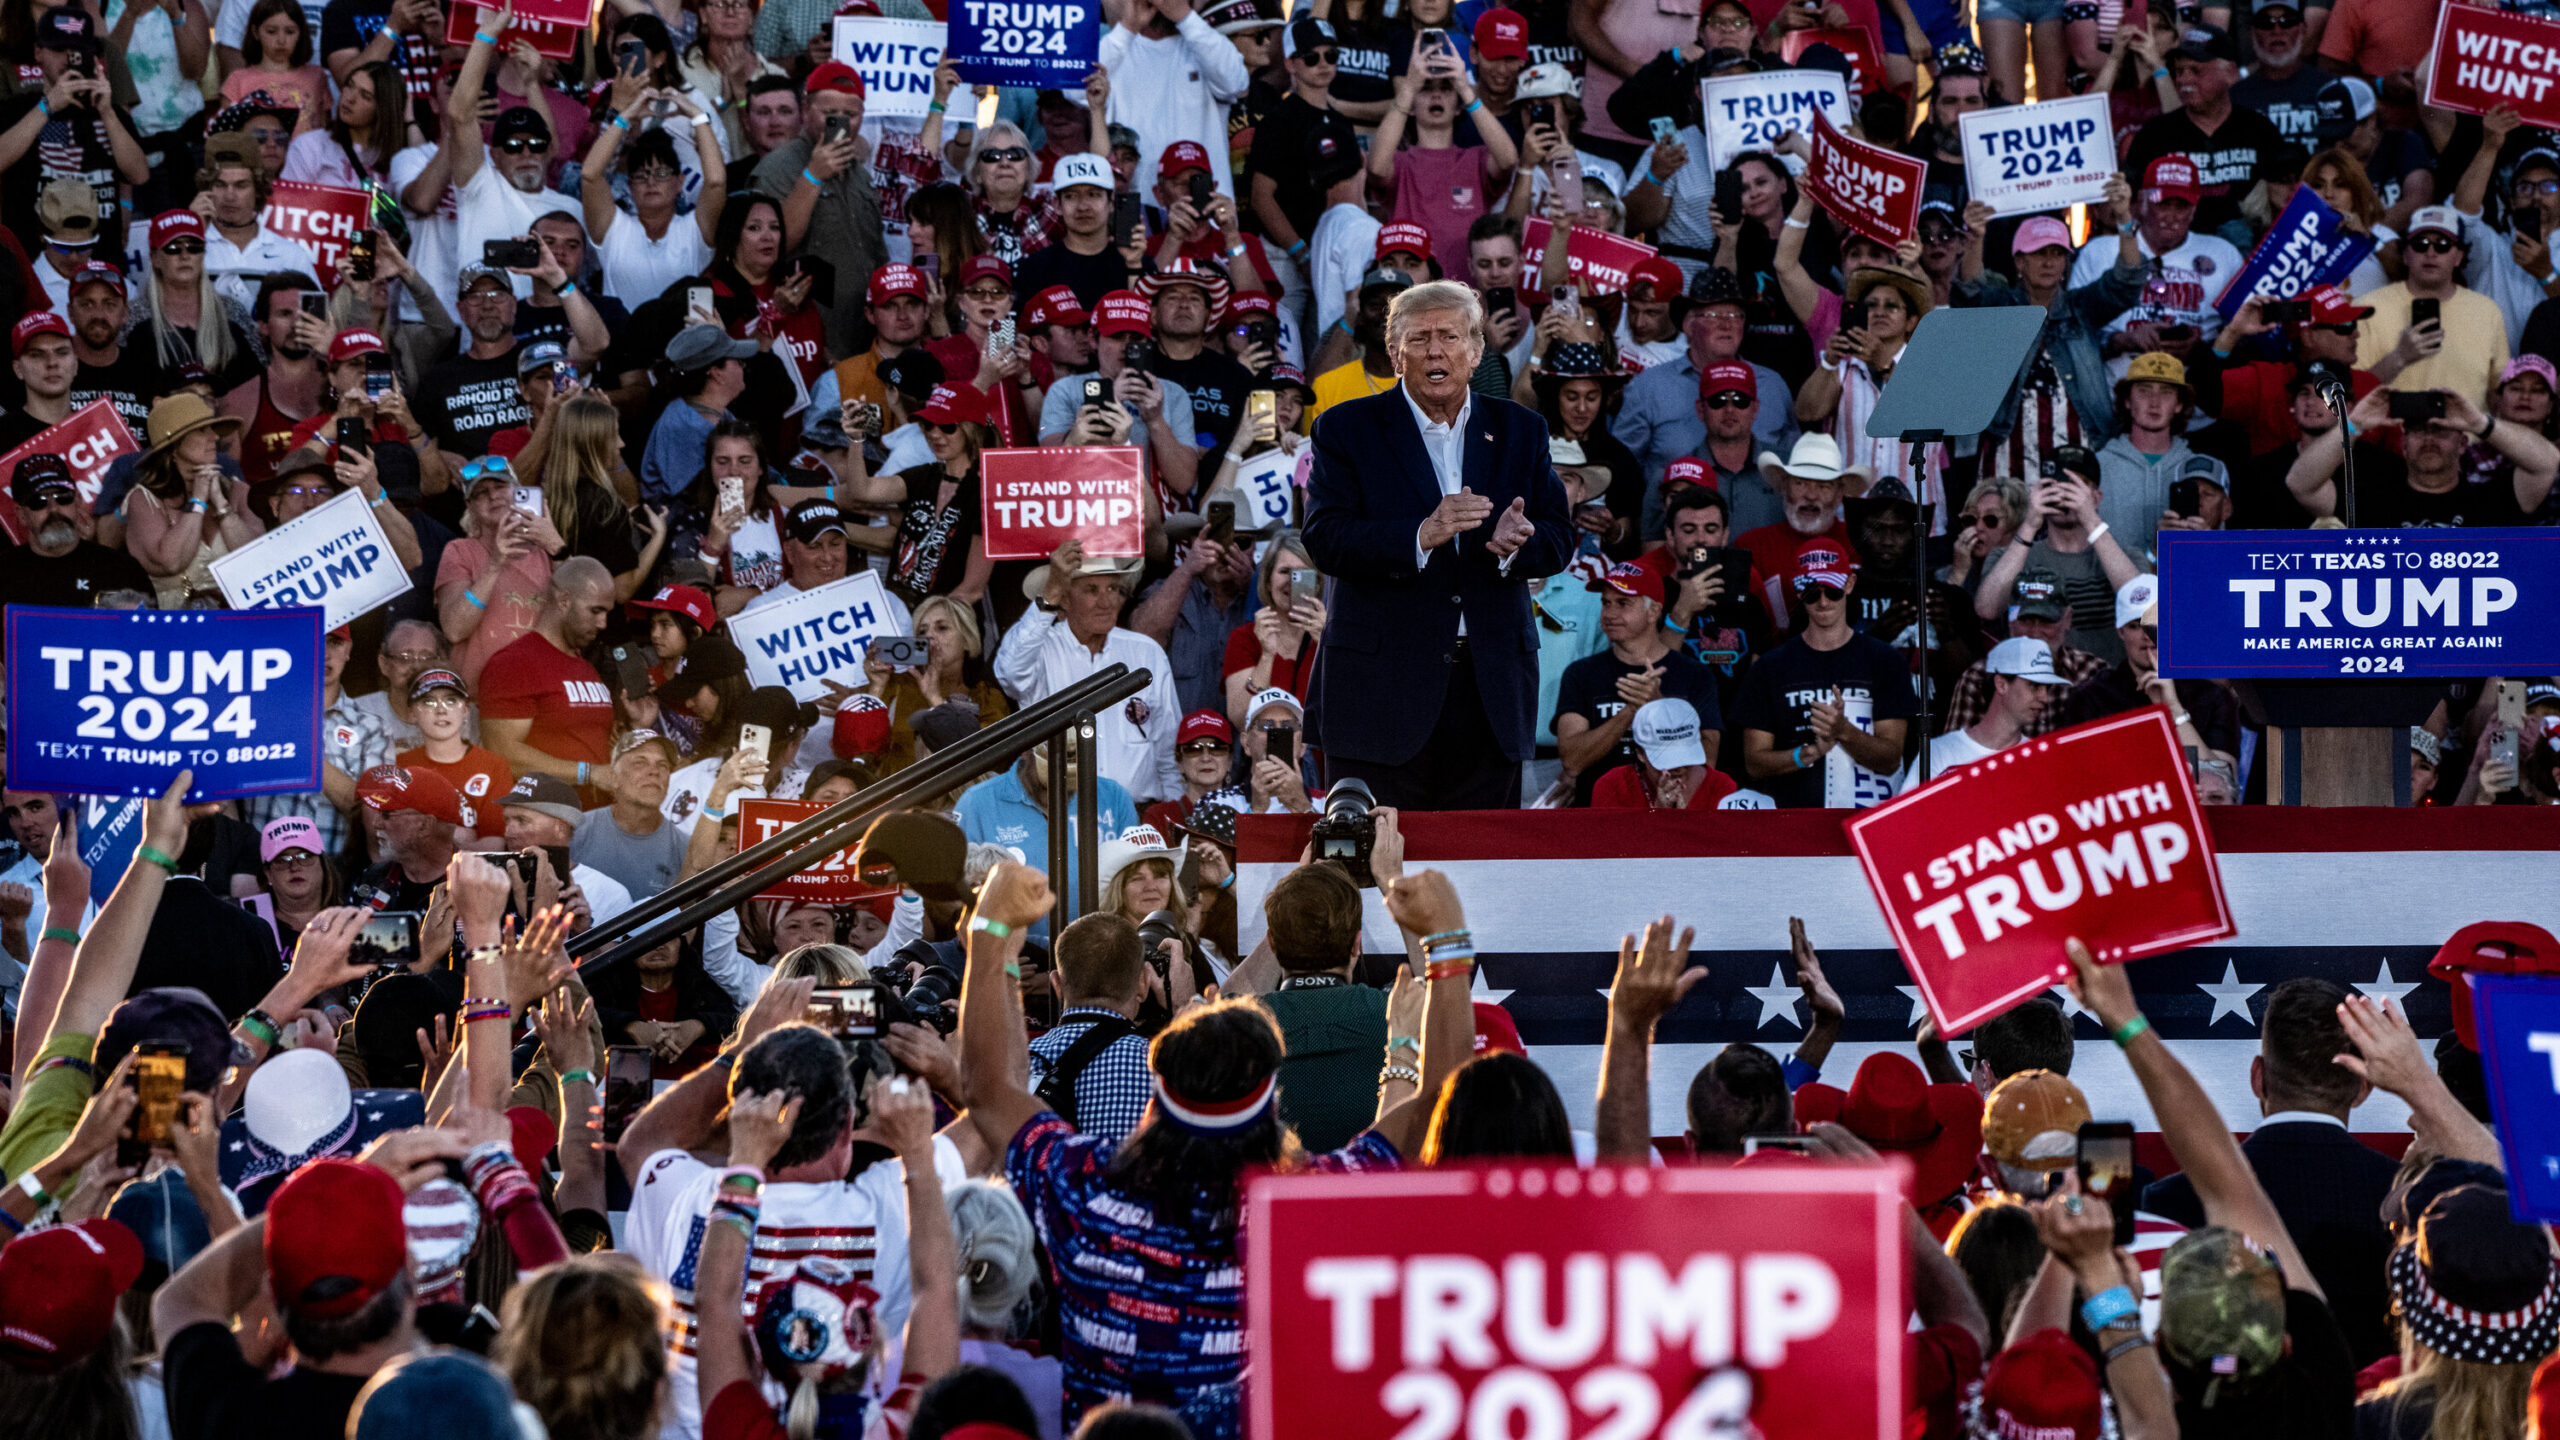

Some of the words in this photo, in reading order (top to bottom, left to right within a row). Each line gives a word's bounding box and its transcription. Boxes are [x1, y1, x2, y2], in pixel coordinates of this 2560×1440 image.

[966, 2, 1085, 32] TRUMP
[981, 30, 1067, 55] 2024
[853, 43, 938, 69] WITC
[994, 58, 1031, 69] TRUMP
[1034, 60, 1048, 68] TO
[1053, 60, 1085, 70] 88022
[1336, 47, 1391, 72] RUMP
[2457, 62, 2554, 103] HUNT
[1722, 91, 1835, 120] TRUMP
[1980, 118, 2095, 156] TRUMP
[1067, 162, 1100, 178] USA
[1817, 131, 1907, 197] TRUMP
[2002, 146, 2084, 179] 2024
[1823, 164, 1886, 216] 2024
[2016, 180, 2052, 191] TRUMP
[2073, 172, 2106, 184] 88022
[157, 214, 199, 231] TRUMP
[880, 273, 918, 284] AMERICA
[886, 264, 909, 275] KEEP
[1107, 309, 1128, 320] GREAT
[343, 332, 382, 347] TRUMP
[485, 380, 502, 391] LET
[454, 411, 495, 432] ROAD
[996, 483, 1002, 497] I
[1007, 482, 1071, 497] STAND
[1077, 480, 1129, 495] WITH
[797, 505, 839, 523] TRUMP
[994, 499, 1132, 529] TRUMP
[241, 588, 251, 601] I
[253, 555, 314, 594] STAND
[317, 526, 367, 559] WITH
[2247, 553, 2305, 570] TEXT
[2310, 553, 2386, 570] TEXAS
[2392, 552, 2422, 570] TO
[2429, 551, 2500, 569] 88022
[2229, 577, 2518, 628] TRUMP
[757, 602, 876, 659] WITCH
[2243, 638, 2291, 650] MAKE
[2297, 638, 2375, 649] AMERICA
[2380, 637, 2436, 649] GREAT
[2442, 636, 2503, 648] AGAIN!
[41, 646, 293, 695] TRUMP
[2340, 656, 2405, 673] 2024
[77, 694, 258, 742] 2024
[37, 741, 95, 759] TEXT
[102, 746, 183, 767] TRUMP
[191, 748, 221, 766] TO
[227, 742, 297, 763] 88022
[268, 823, 311, 840] TRUMP
[1902, 871, 1923, 902] I
[1927, 813, 2060, 890] STAND
[2065, 781, 2173, 832] WITH
[85, 832, 112, 868] TEXT
[834, 874, 849, 884] TO
[1913, 821, 2190, 961] TRUMP
[1296, 976, 1336, 987] SONY
[1303, 1250, 1841, 1372] TRUMP
